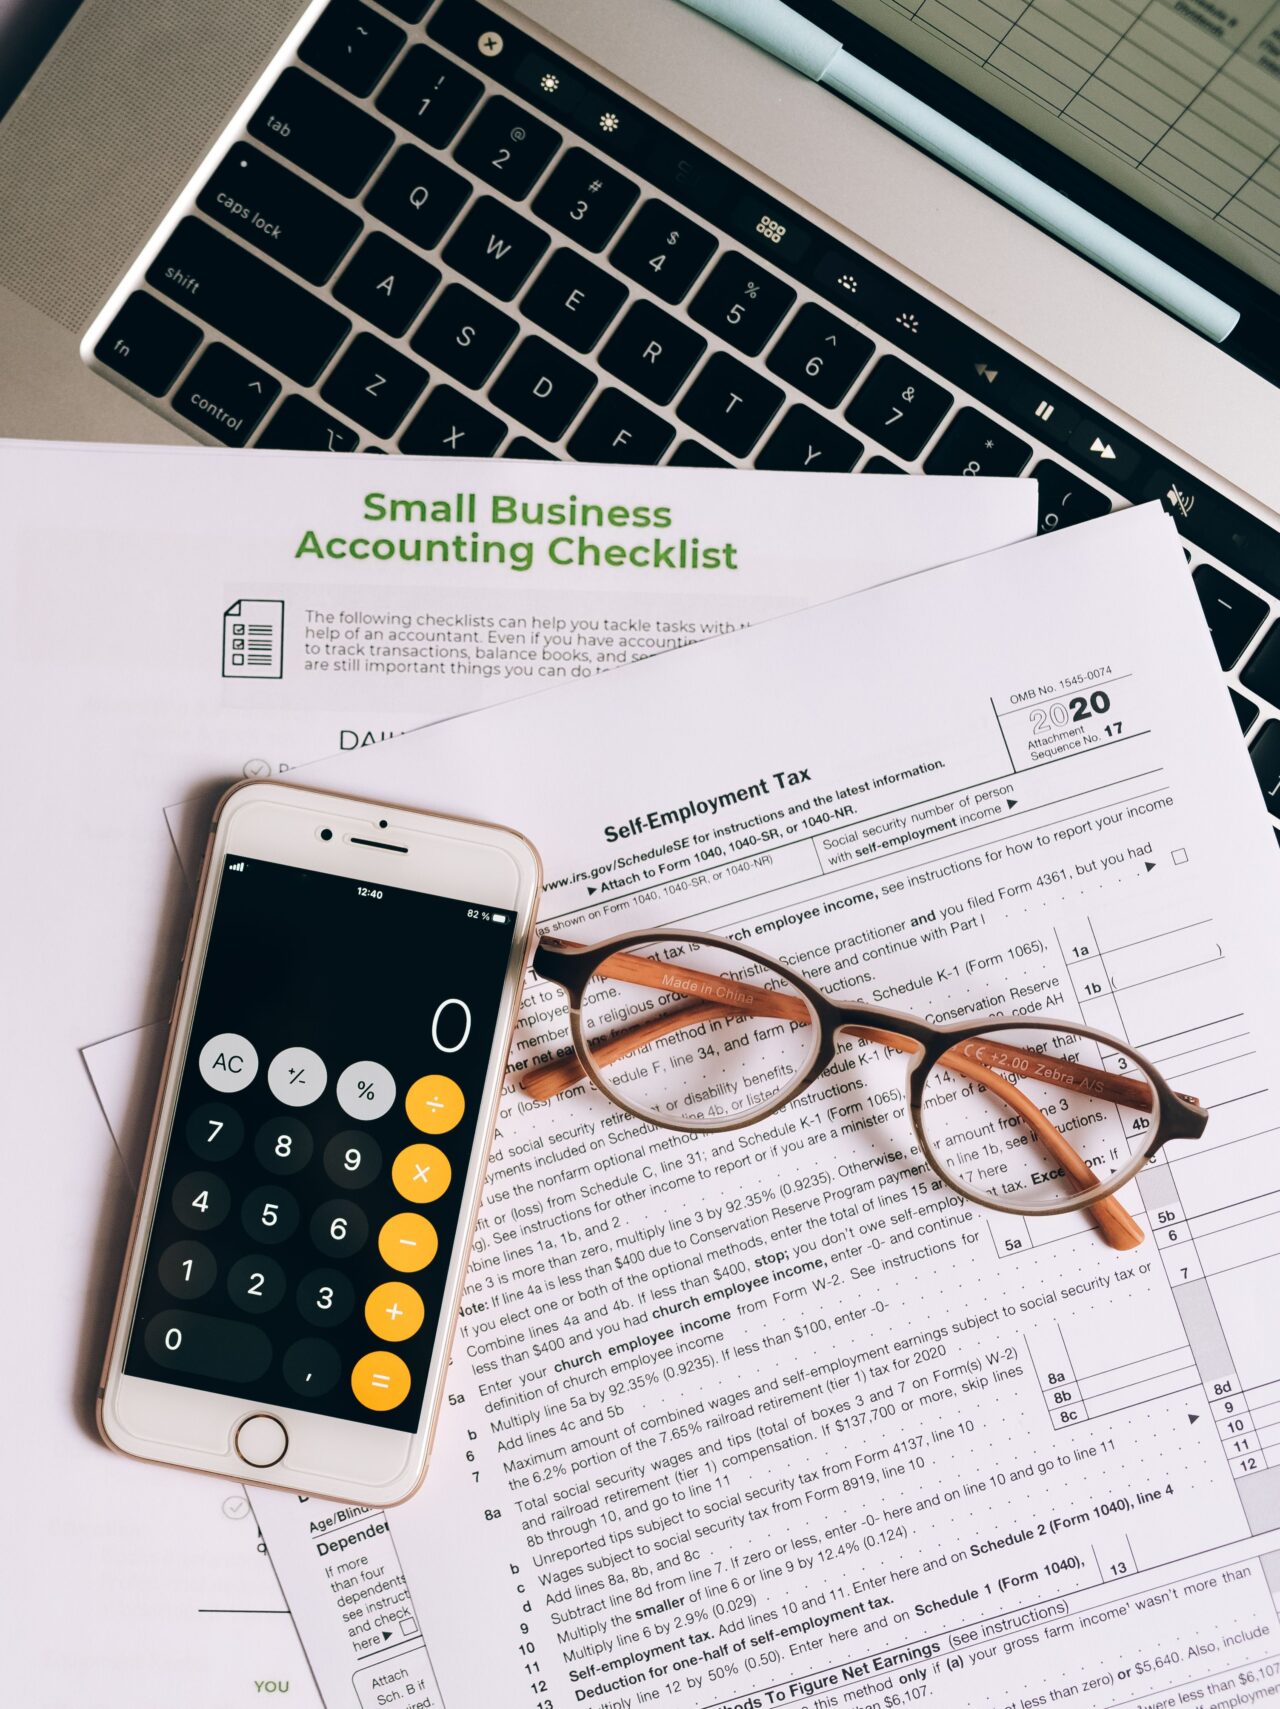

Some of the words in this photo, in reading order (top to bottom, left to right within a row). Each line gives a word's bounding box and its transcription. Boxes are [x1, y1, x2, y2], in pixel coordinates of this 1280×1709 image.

[419, 99, 430, 115] 1
[267, 116, 290, 136] tab
[492, 149, 510, 169] 2
[410, 187, 428, 209] Q
[216, 191, 248, 220] caps
[251, 213, 282, 240] lock
[570, 201, 587, 220] 3
[487, 235, 511, 259] W
[649, 255, 666, 272] 4
[165, 265, 200, 294] shift
[377, 276, 394, 296] A
[565, 289, 584, 311] E
[727, 304, 745, 323] 5
[457, 327, 475, 346] S
[114, 340, 129, 356] fn
[643, 341, 662, 363] R
[806, 357, 823, 376] 6
[365, 374, 386, 396] Z
[533, 377, 552, 397] D
[190, 392, 243, 431] control
[726, 393, 742, 413] T
[885, 407, 903, 425] 7
[443, 426, 464, 449] X
[613, 430, 632, 446] F
[805, 445, 821, 465] Y
[963, 461, 980, 476] 8
[363, 492, 477, 524] Small
[491, 494, 673, 529] Business
[1041, 513, 1059, 532] 9
[293, 529, 534, 573] Accounting
[547, 535, 739, 571] Checklist
[304, 609, 336, 625] The
[339, 610, 413, 630] following
[415, 612, 495, 629] checklists
[498, 617, 527, 629] can
[531, 615, 567, 633] help
[569, 619, 600, 634] you
[603, 617, 652, 633] tackle
[655, 619, 697, 634] tasks
[699, 620, 739, 637] with
[304, 625, 341, 643] help
[344, 626, 361, 641] of
[364, 629, 384, 641] an
[487, 629, 526, 645] Even
[530, 631, 541, 645] if
[542, 634, 573, 647] you
[576, 632, 615, 648] have
[304, 642, 321, 656] to
[324, 642, 366, 657] track
[369, 644, 471, 662] transactions,
[474, 645, 538, 661] balance
[541, 646, 593, 665] books,
[595, 649, 627, 664] and
[1009, 688, 1037, 705] OMB
[1037, 684, 1057, 697] No.
[1058, 665, 1113, 689] 1545-0074
[1028, 689, 1111, 736] 2020
[1027, 724, 1086, 751] Attachment
[1030, 739, 1082, 762] Sequence
[1083, 733, 1102, 746] No.
[1104, 721, 1124, 738] 17
[603, 778, 771, 844] Self-Employment
[771, 767, 813, 790] Tax
[692, 832, 711, 846] for
[711, 809, 786, 840] instructions
[787, 798, 812, 816] and
[812, 794, 834, 808] the
[834, 781, 871, 801] latest
[871, 760, 946, 789] information.
[822, 829, 860, 851] Social
[861, 816, 907, 839] security
[910, 801, 955, 824] number
[958, 794, 971, 808] of
[973, 784, 1015, 806] person
[827, 850, 853, 866] with
[854, 816, 959, 858] self-employment
[958, 804, 1003, 825] income
[600, 872, 642, 894] Attach
[642, 868, 657, 880] to
[657, 857, 692, 875] Form
[693, 845, 727, 863] 1040,
[728, 827, 784, 853] 1040-SR,
[785, 823, 799, 835] or
[800, 804, 858, 830] 1040-NR.
[357, 886, 383, 900] 12:40
[467, 909, 479, 918] 82
[1071, 946, 1090, 959] 1a
[872, 975, 934, 1003] Schedule
[936, 964, 960, 983] K-1
[965, 953, 1004, 976] (Form
[1007, 938, 1048, 960] 1065),
[662, 975, 697, 991] Made
[701, 983, 712, 994] in
[716, 987, 753, 1003] China
[1083, 982, 1102, 996] 1b
[924, 993, 1007, 1025] Conservation
[1008, 977, 1060, 1001] Reserve
[432, 999, 471, 1053] 0
[212, 1053, 243, 1073] AC
[991, 1053, 1029, 1071] +2.00
[1035, 1063, 1074, 1085] Zebra
[1080, 1077, 1105, 1093] A/S
[208, 1120, 223, 1142] 7
[275, 1135, 292, 1157] 8
[344, 1149, 361, 1171] 9
[192, 1191, 208, 1212] 4
[262, 1204, 278, 1226] 5
[1157, 1209, 1176, 1224] 5b
[331, 1218, 347, 1240] 6
[183, 1260, 192, 1281] 1
[1179, 1266, 1188, 1280] 7
[248, 1273, 264, 1296] 2
[317, 1287, 333, 1309] 3
[165, 1328, 181, 1350] 0
[1047, 1372, 1067, 1385] 8a
[1213, 1379, 1233, 1396] 8d
[1053, 1389, 1073, 1405] 8b
[1059, 1410, 1079, 1424] 8c
[1239, 1457, 1258, 1472] 12
[324, 1565, 335, 1579] If
[336, 1555, 369, 1575] more
[1109, 1561, 1128, 1576] 13
[329, 1576, 360, 1594] than
[359, 1565, 385, 1583] four
[347, 1618, 373, 1638] and
[373, 1605, 412, 1628] check
[562, 1639, 613, 1664] Multiply
[615, 1632, 641, 1647] line
[642, 1625, 652, 1639] 6
[653, 1621, 671, 1636] by
[673, 1607, 709, 1630] 2.9%
[711, 1593, 757, 1620] (0.029)
[574, 1672, 647, 1703] Deduction
[647, 1664, 669, 1680] for
[671, 1642, 729, 1672] one-half
[732, 1637, 747, 1653] of
[749, 1601, 867, 1648] self-employment
[866, 1595, 895, 1610] tax.
[763, 1689, 787, 1705] To
[788, 1674, 839, 1698] Figure
[840, 1661, 871, 1682] Net
[871, 1642, 941, 1672] Earnings
[948, 1630, 979, 1650] (see
[980, 1598, 1070, 1638] instructions)
[251, 1681, 290, 1694] YOU
[371, 1667, 409, 1691] Attach
